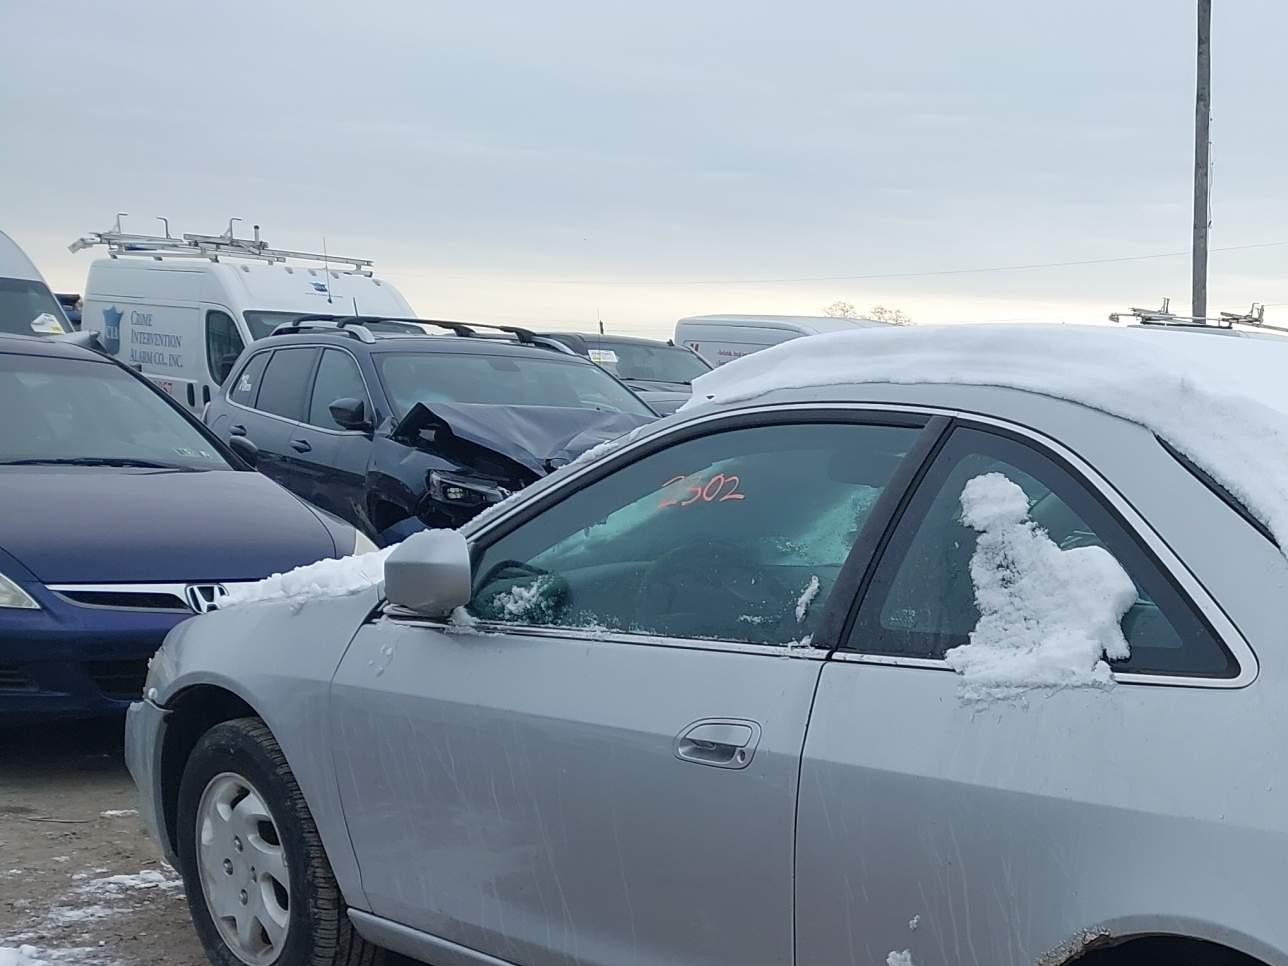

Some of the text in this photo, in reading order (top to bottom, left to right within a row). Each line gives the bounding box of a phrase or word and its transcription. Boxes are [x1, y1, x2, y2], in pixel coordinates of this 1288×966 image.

[130, 310, 153, 327] CRIME
[130, 328, 182, 348] INTERVENTION
[129, 348, 153, 365] ALARM
[168, 354, 184, 369] INC.
